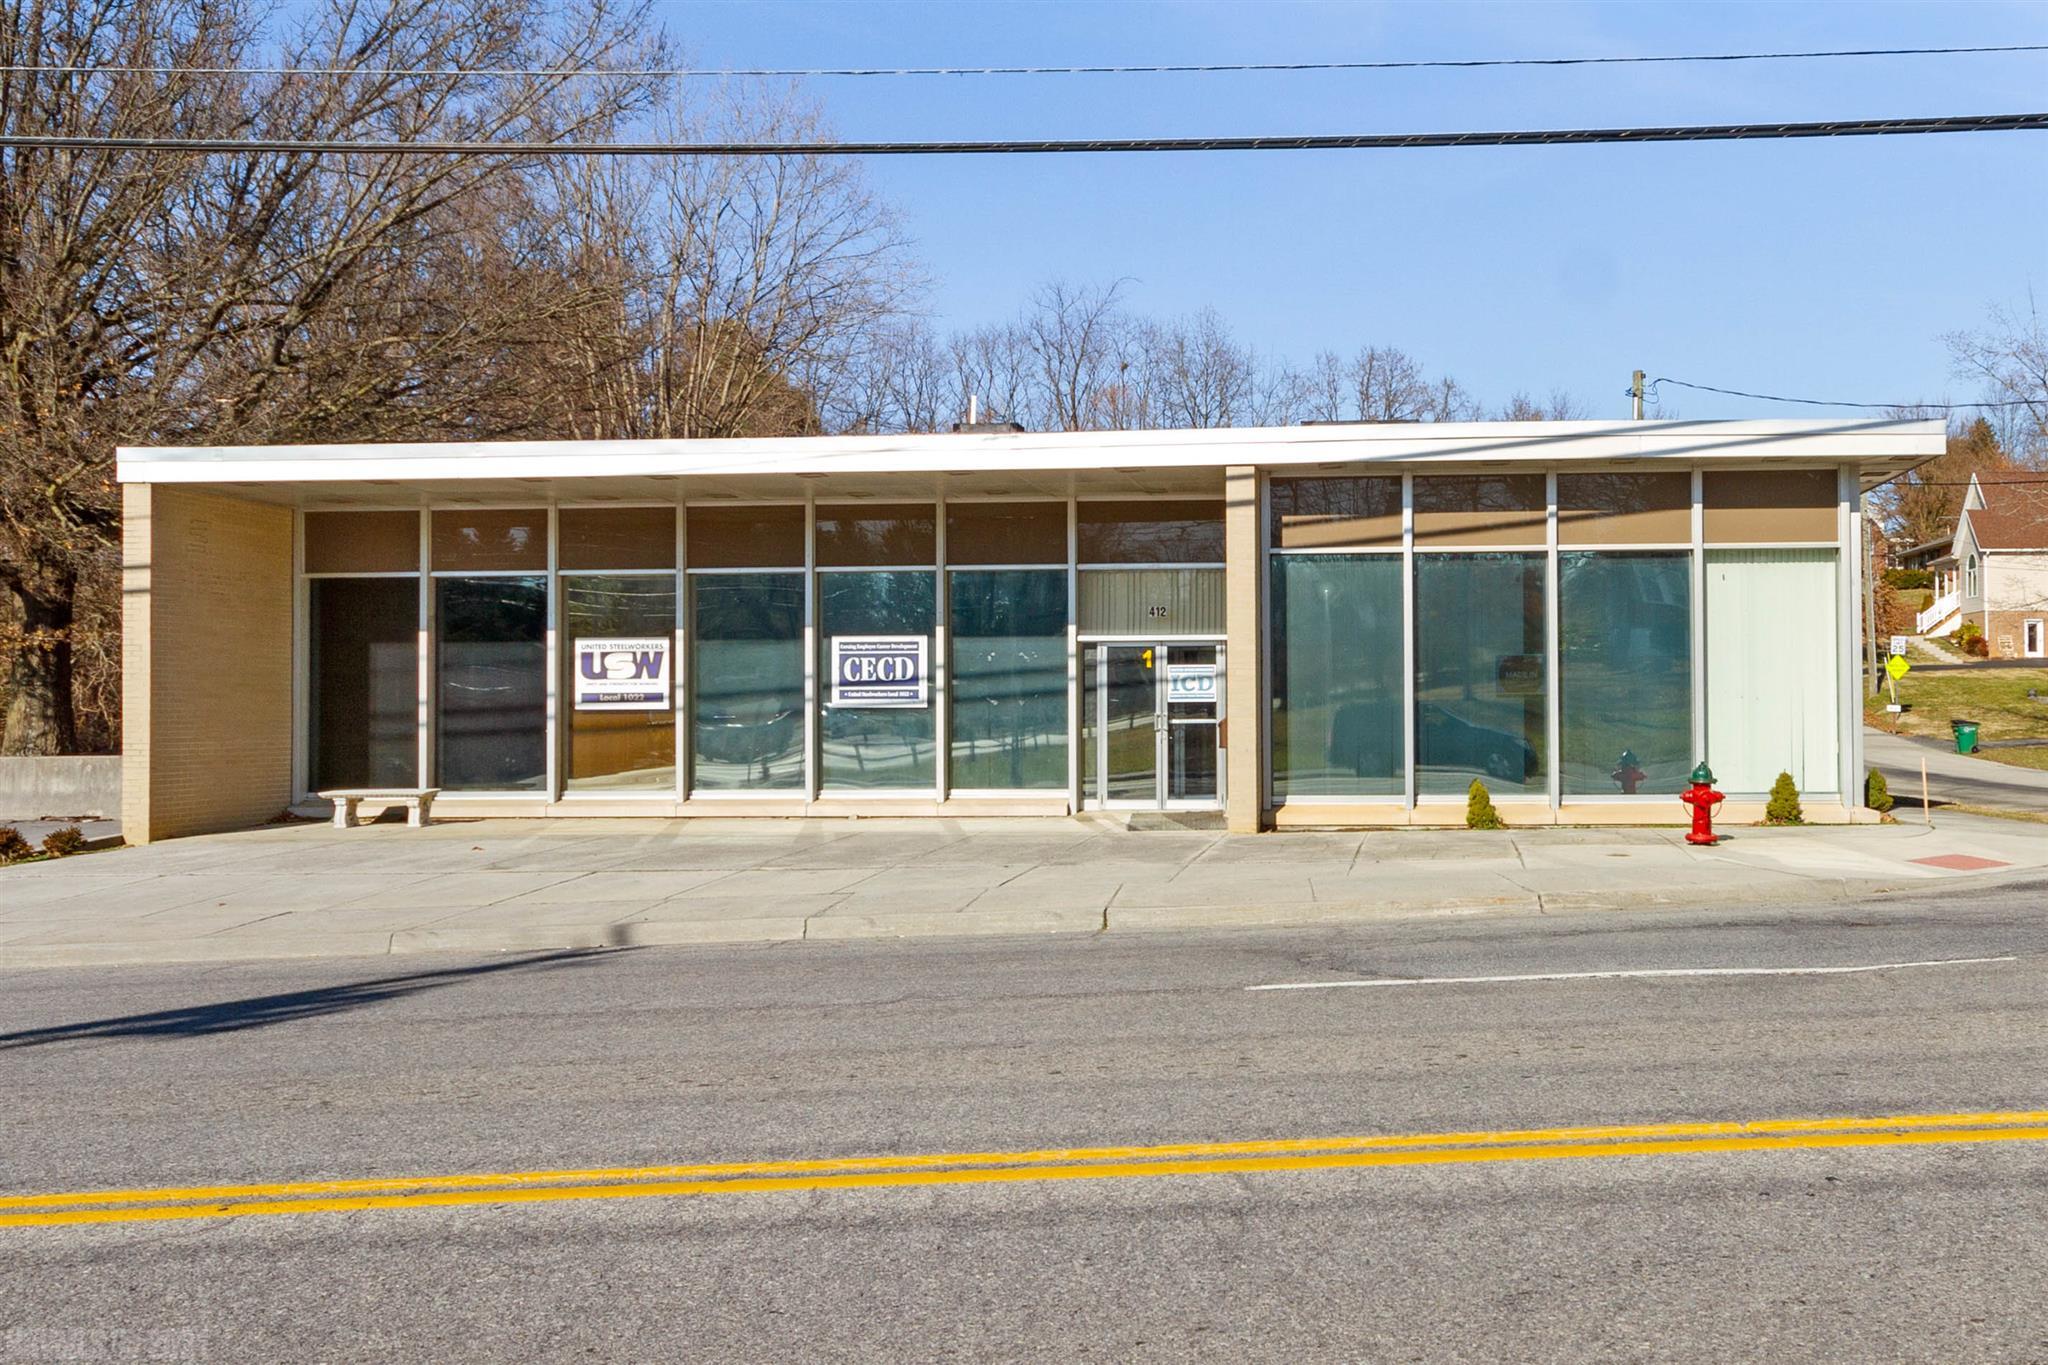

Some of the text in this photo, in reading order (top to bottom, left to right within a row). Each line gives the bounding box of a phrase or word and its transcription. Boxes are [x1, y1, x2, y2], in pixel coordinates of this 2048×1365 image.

[1149, 606, 1167, 617] 412
[1892, 645, 1905, 653] 25
[580, 651, 665, 680] USW
[843, 656, 915, 682] CECD
[1170, 674, 1214, 692] ICD
[600, 693, 645, 702] Local 1022
